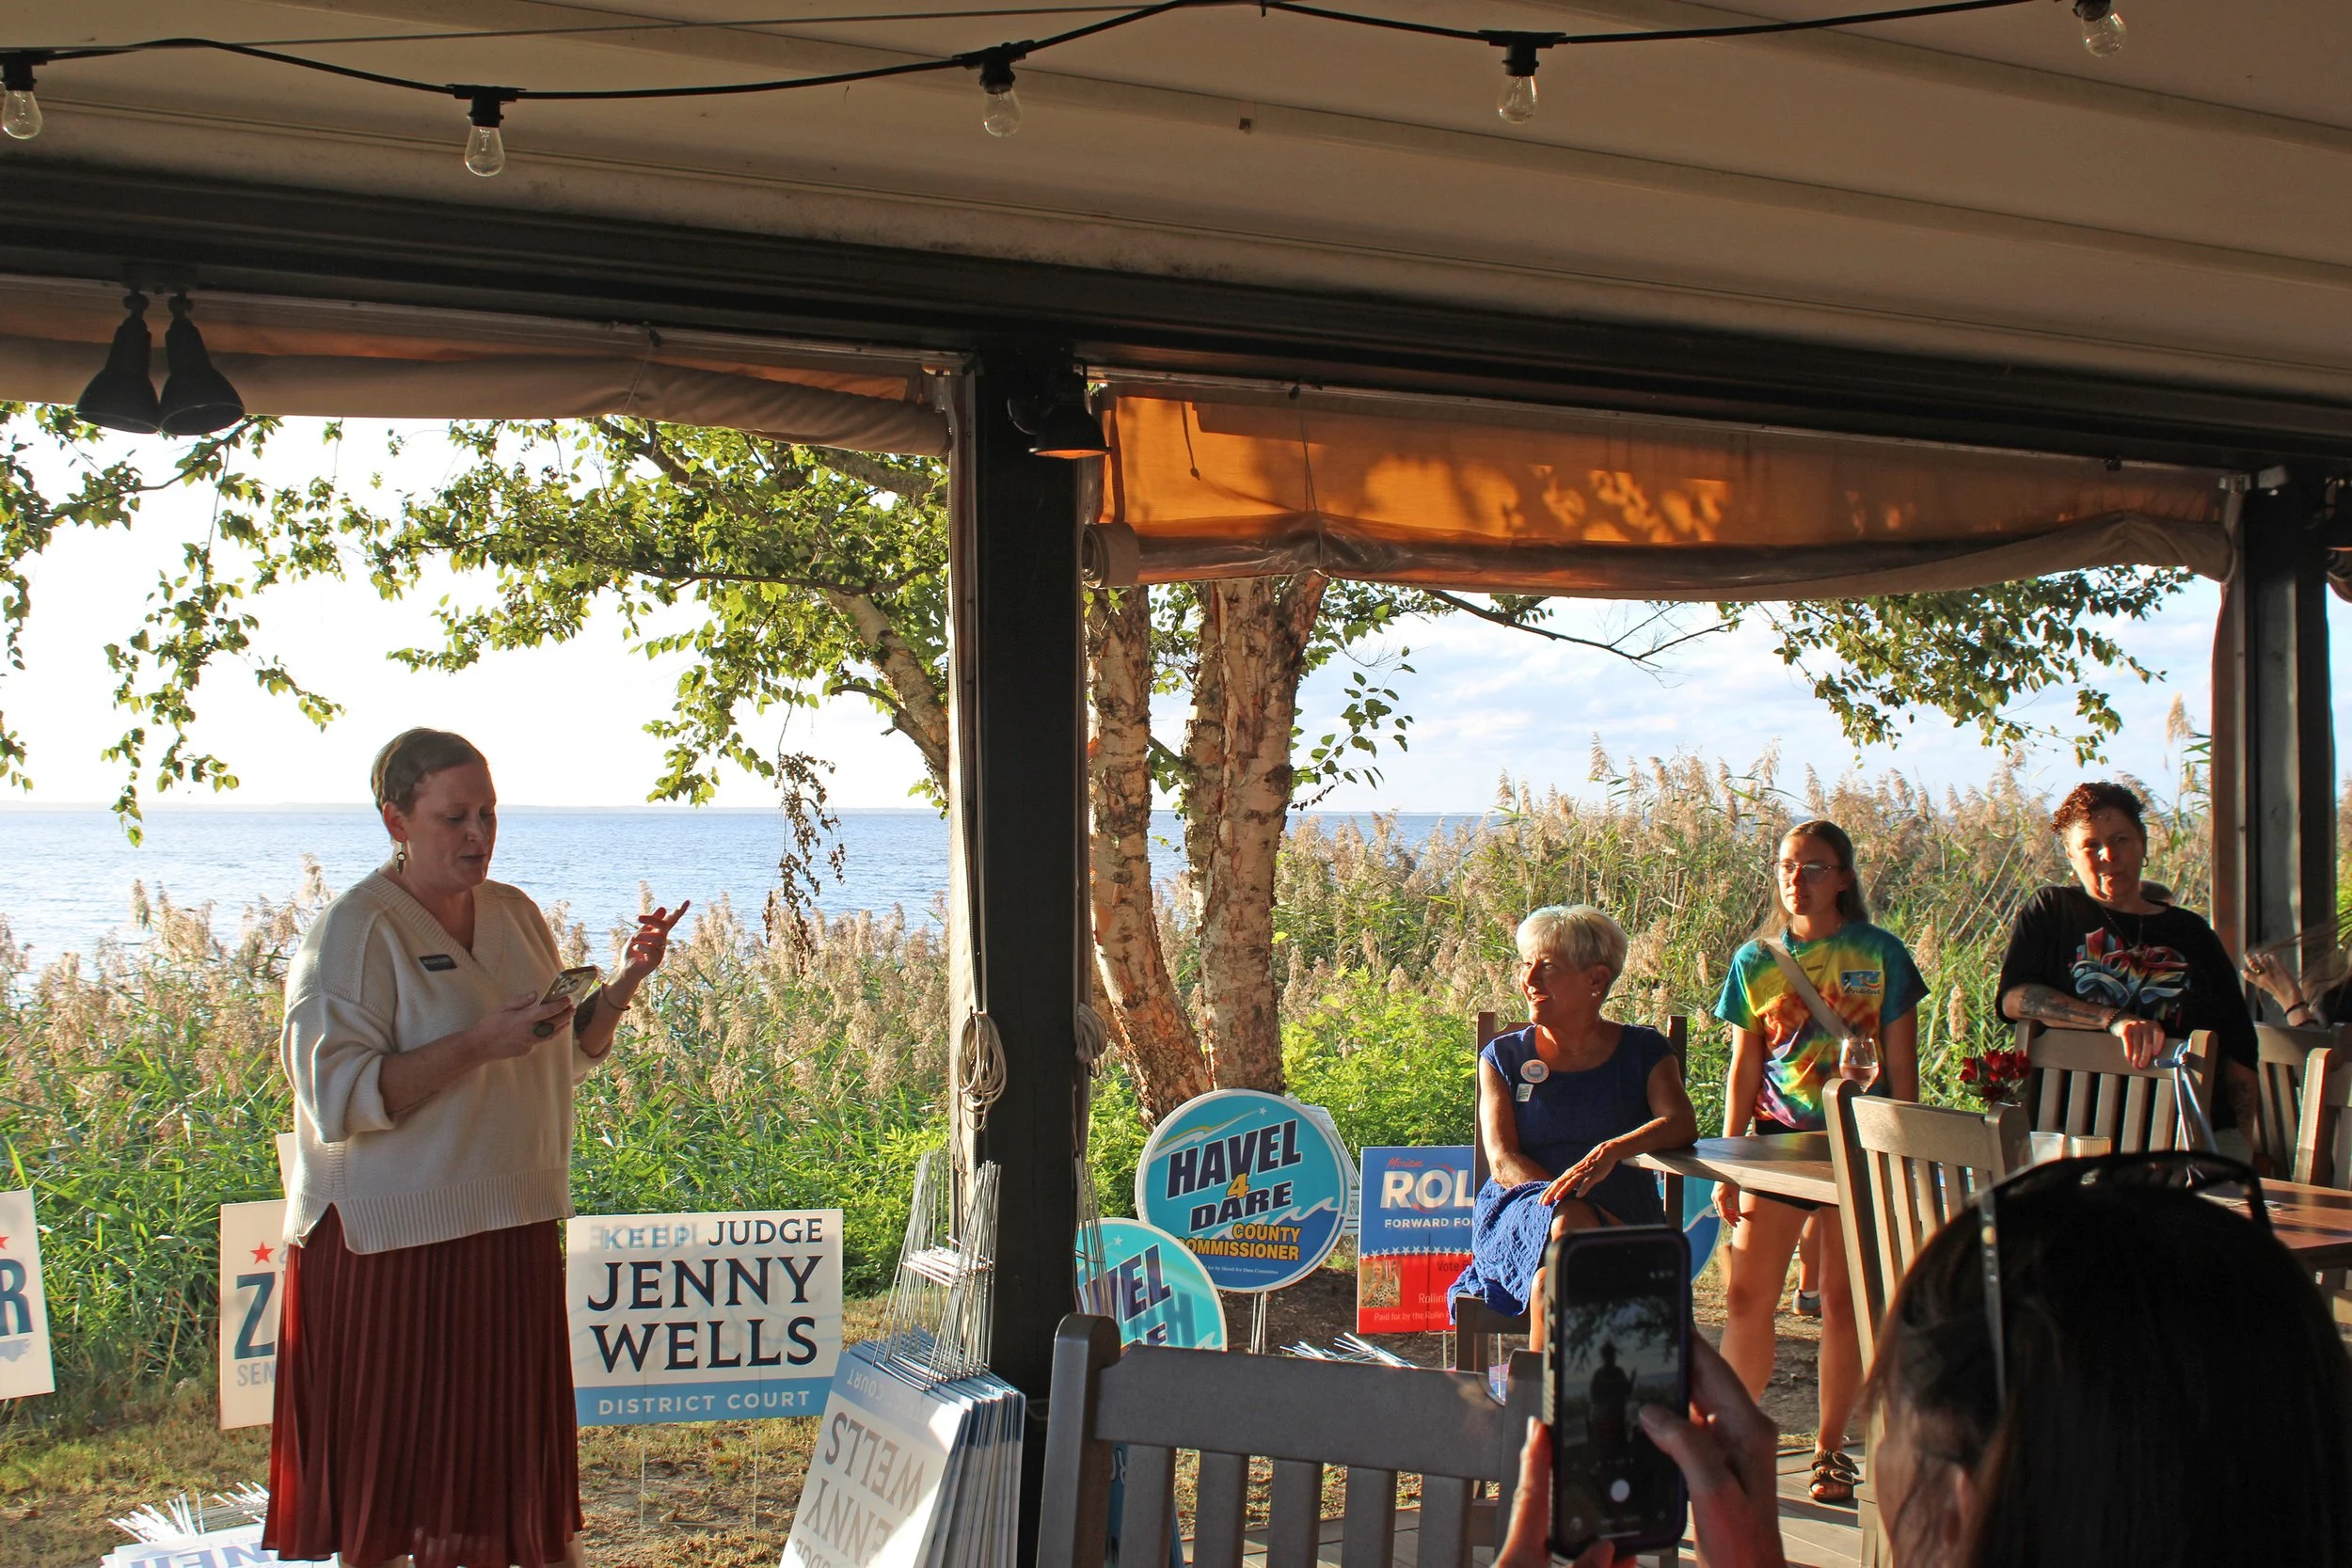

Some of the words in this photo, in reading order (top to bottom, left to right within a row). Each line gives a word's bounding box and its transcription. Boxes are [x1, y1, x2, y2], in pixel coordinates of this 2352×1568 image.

[1167, 1118, 1302, 1200] HAVEL
[1226, 1172, 1250, 1199] 4
[1189, 1180, 1294, 1233] DARE
[1384, 1218, 1450, 1228] FORWARD
[1454, 1217, 1474, 1227] FO
[603, 1226, 691, 1250] KEEP
[707, 1218, 823, 1246] JUDGE
[1232, 1222, 1302, 1243] COUNTY
[1176, 1237, 1300, 1261] OMMISSIONER
[1438, 1261, 1459, 1272] Vote
[587, 1255, 824, 1311] JENNY
[1374, 1312, 1391, 1321] Paid
[1402, 1312, 1411, 1323] by
[589, 1316, 818, 1373] WELLS
[847, 1369, 884, 1402] COURT
[598, 1395, 716, 1416] DISTRICT
[726, 1390, 811, 1410] COURT
[824, 1411, 926, 1516] WELLS
[802, 1478, 894, 1566] ENNY
